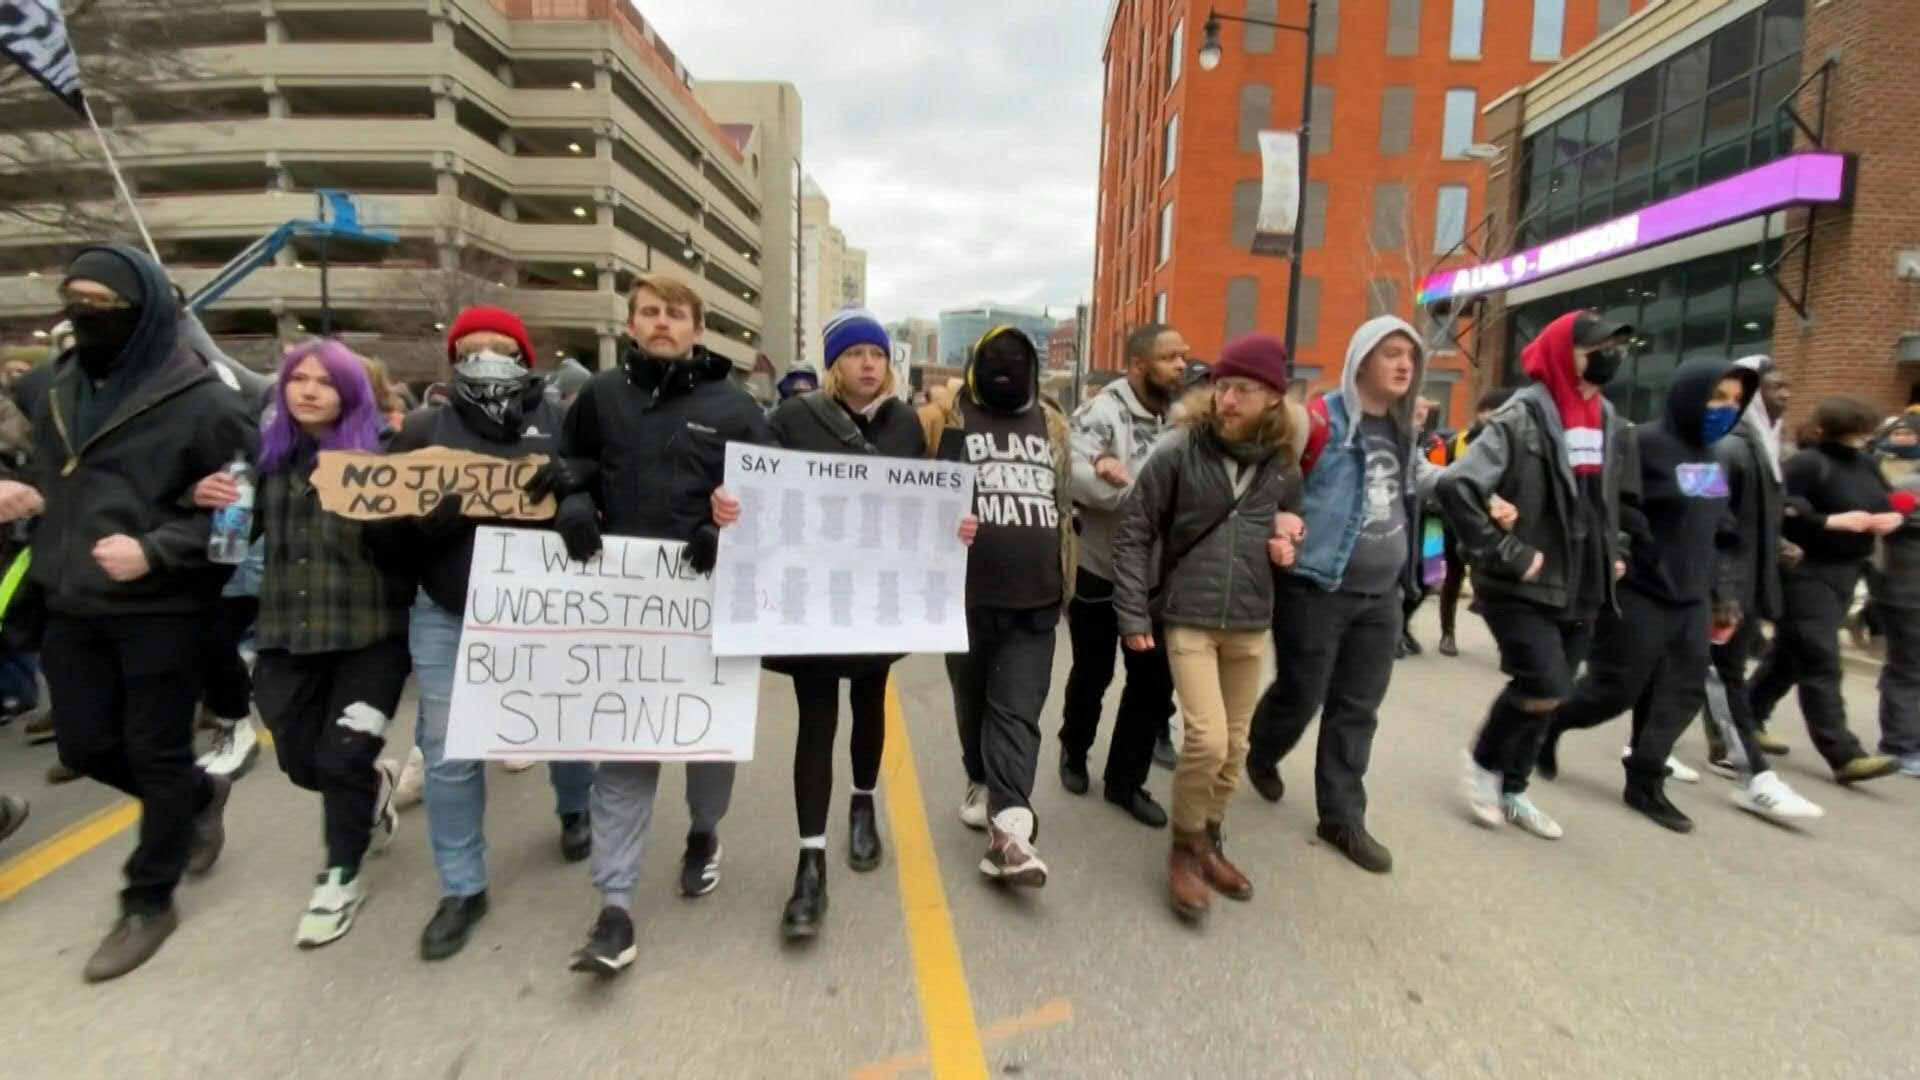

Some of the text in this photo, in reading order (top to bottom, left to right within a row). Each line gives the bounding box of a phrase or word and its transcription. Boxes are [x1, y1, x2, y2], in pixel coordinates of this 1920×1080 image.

[341, 462, 533, 494] NO JUSTIC
[741, 454, 962, 489] SAY THEIR NAMES
[349, 488, 537, 517] NO PACE
[491, 532, 517, 574] I
[472, 587, 712, 632] UNDERSTAND
[466, 642, 549, 685] BUT
[565, 643, 685, 684] STILL
[496, 690, 712, 746] STAND
